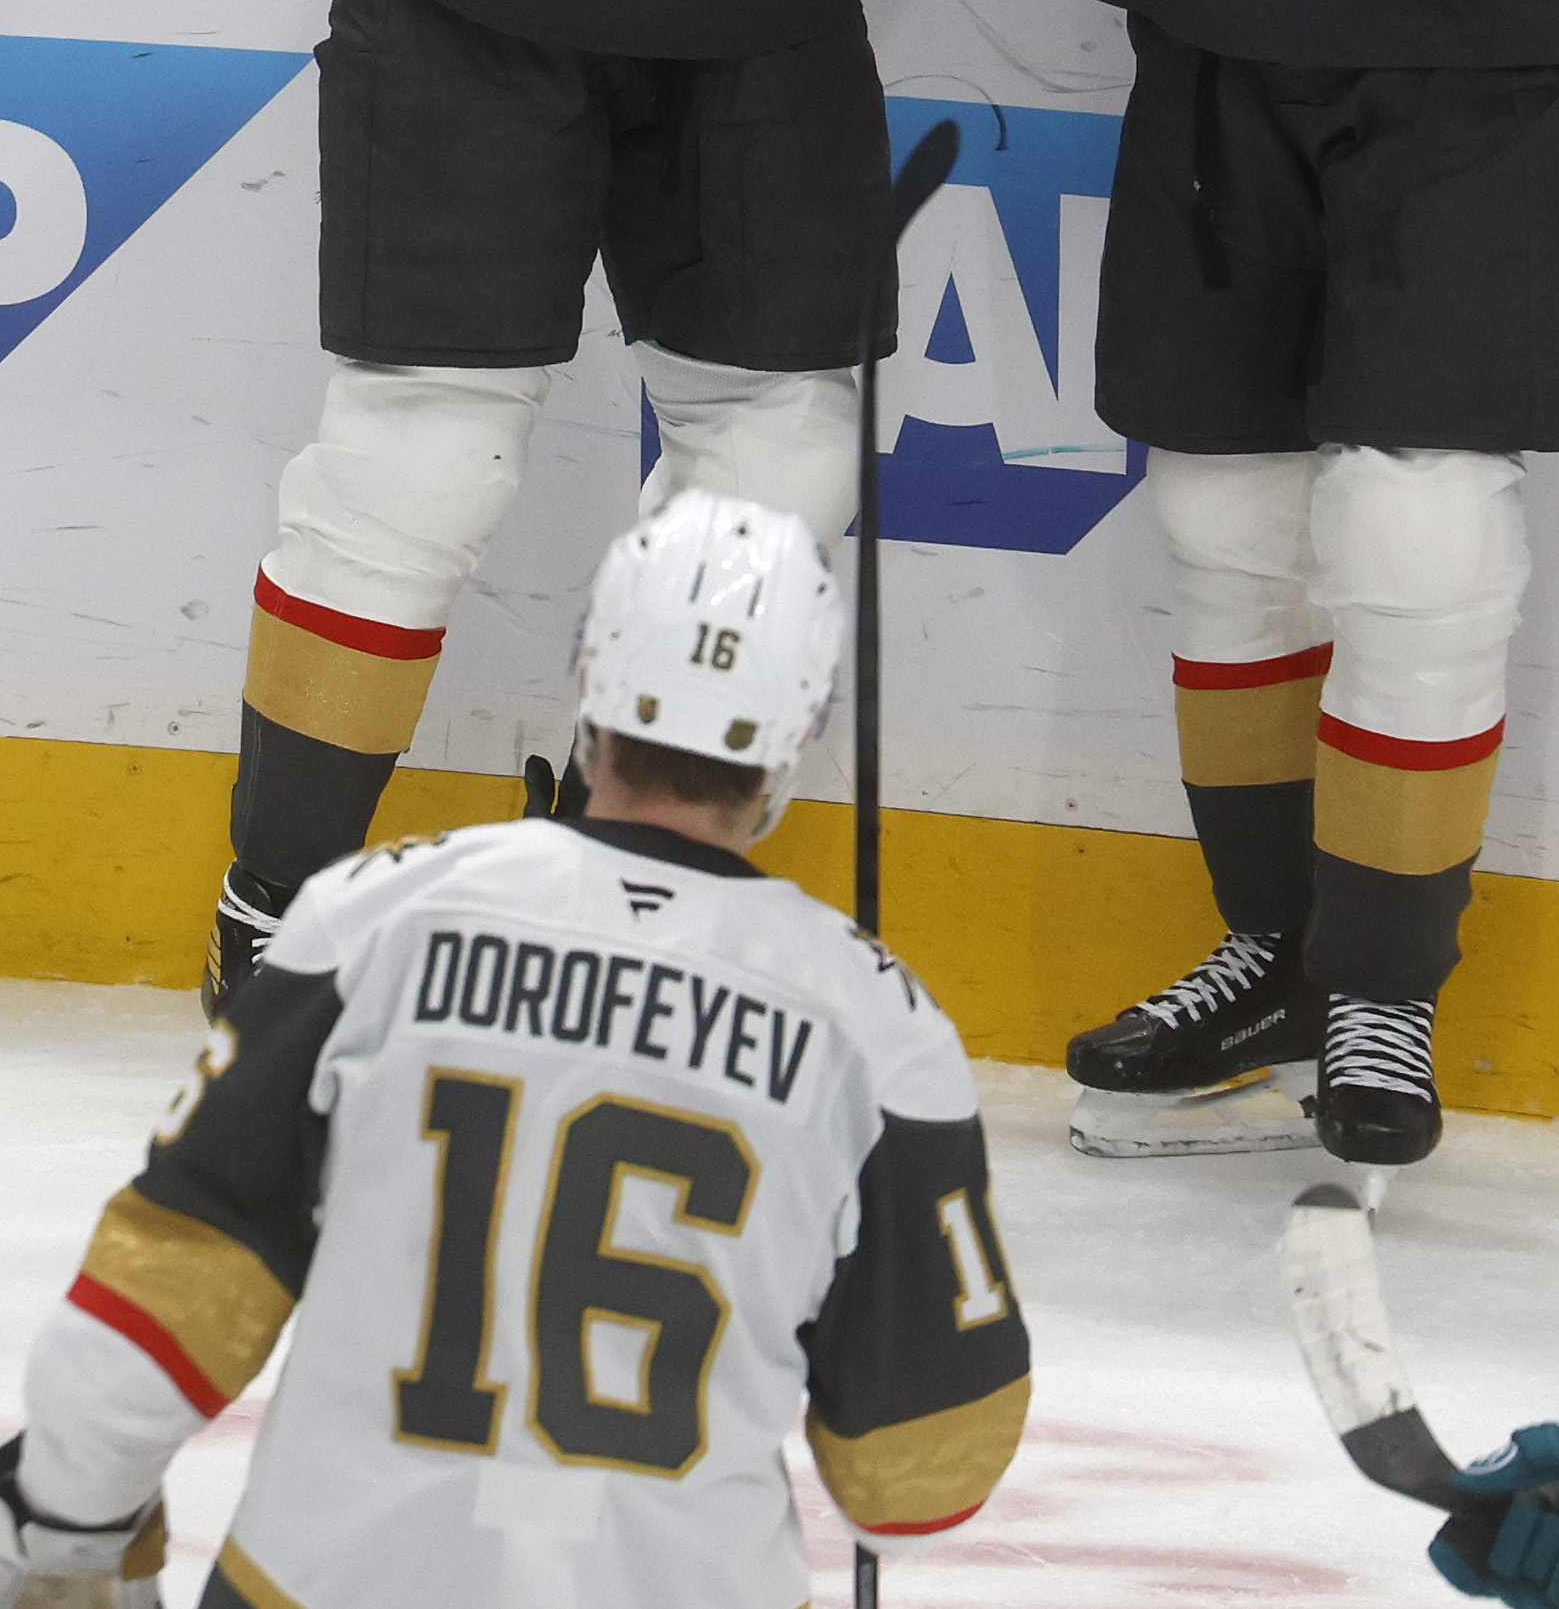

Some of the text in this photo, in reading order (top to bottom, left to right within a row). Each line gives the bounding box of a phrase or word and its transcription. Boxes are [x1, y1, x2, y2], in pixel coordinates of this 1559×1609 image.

[686, 621, 740, 672] 16
[413, 929, 813, 1105] DOROFEYEV
[1220, 1007, 1287, 1052] BAUER
[391, 1065, 761, 1482] 16
